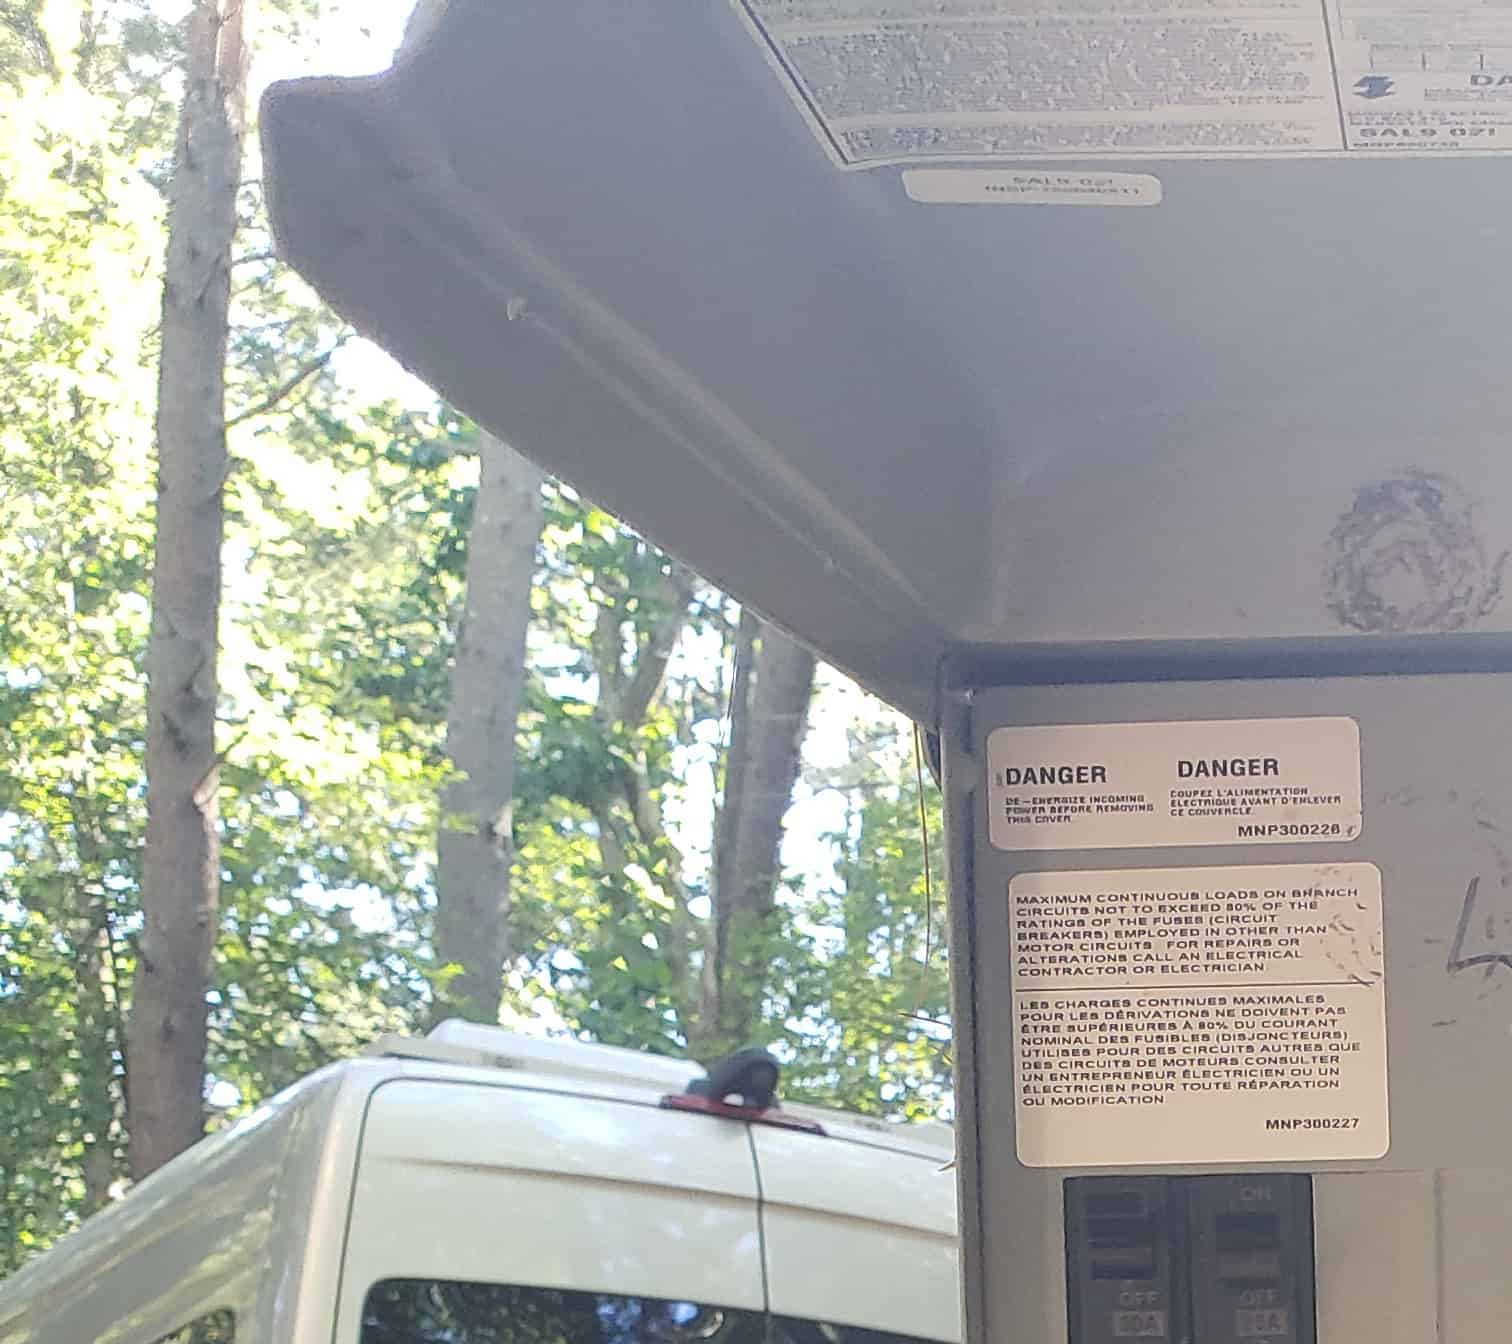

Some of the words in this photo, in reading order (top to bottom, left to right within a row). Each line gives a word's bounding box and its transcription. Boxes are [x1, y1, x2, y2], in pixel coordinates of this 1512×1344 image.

[1006, 766, 1106, 784] DANGER
[1178, 759, 1279, 777] DANGER
[1089, 795, 1144, 803] INCOMING
[1170, 789, 1212, 797] COUPEZ
[1216, 788, 1308, 796] L'ALIMENTATION
[1281, 796, 1341, 804] D'ENLEVER
[1005, 806, 1046, 814] POWER
[1049, 805, 1092, 813] BEFORE
[1096, 804, 1154, 812] REMOVING
[1170, 808, 1184, 816] CE
[1016, 895, 1092, 904] MAXIMUM
[1096, 892, 1199, 902] CONTINUOUS
[1205, 890, 1258, 900] LOADS
[1263, 890, 1286, 898] ON
[1291, 888, 1358, 897] BRANCH
[1016, 907, 1090, 916] CIRCUITS
[1094, 906, 1127, 914] NOT
[1131, 905, 1153, 913] TO
[1158, 903, 1221, 912] EXCEED
[1226, 903, 1256, 911] 80%
[1261, 902, 1282, 910] OF
[1288, 901, 1317, 910] THE
[1016, 919, 1086, 928] RATINGS
[1090, 918, 1112, 926] OF
[1117, 917, 1147, 925] THE
[1152, 916, 1203, 925] FUSES
[1208, 914, 1278, 924] (CIRCUIT
[1017, 931, 1109, 940] BREAKERS)
[1114, 928, 1200, 938] EMPLOYED
[1205, 927, 1220, 936] IN
[1225, 926, 1279, 935] OTHER
[1287, 925, 1331, 934] THAN
[1017, 943, 1074, 952] MOTOR
[1079, 941, 1152, 950] CIRCUITS
[1166, 940, 1198, 949] FOR
[1204, 938, 1272, 948] REPAIRS
[1277, 938, 1300, 946] OR
[1017, 954, 1127, 964] ALTERATIONS
[1132, 953, 1174, 961] CALL
[1178, 952, 1200, 960] AN
[1206, 950, 1303, 960] ELECTRICAL
[1018, 966, 1127, 976] CONTRACTOR
[1129, 965, 1155, 973] OR
[1020, 1001, 1049, 1009] LES
[1054, 999, 1131, 1008] CHARGES
[1136, 997, 1227, 1007] CONTINUES
[1232, 995, 1325, 1004] MAXIMALES
[1020, 1012, 1064, 1021] POUR
[1069, 1012, 1099, 1020] LES
[1104, 1010, 1210, 1019] DÉRIVATIONS
[1215, 1009, 1236, 1017] NE
[1241, 1007, 1310, 1016] DOIVENT
[1314, 1007, 1346, 1015] PAS
[1066, 1022, 1178, 1032] SUPÉRIEURES
[1198, 1021, 1229, 1029] 80%
[1234, 1020, 1256, 1029] DU
[1261, 1018, 1338, 1028] COURANT
[1020, 1036, 1093, 1045] NOMINAL
[1098, 1035, 1129, 1043] DES
[1134, 1034, 1210, 1042] FUSIBLES
[1215, 1032, 1348, 1041] (DISJONCTEURS)
[1096, 1047, 1140, 1056] POUR
[1145, 1046, 1177, 1055] DES
[1181, 1045, 1255, 1054] CIRCUITS
[1259, 1043, 1323, 1052] AUTRES
[1328, 1042, 1360, 1051] QUE
[1021, 1061, 1053, 1069] DES
[1057, 1059, 1131, 1069] CIRCUITS
[1136, 1058, 1157, 1067] DE
[1162, 1057, 1239, 1066] MOTEURS
[1241, 1055, 1340, 1065] CONSULTER
[1021, 1073, 1044, 1081] UN
[1049, 1070, 1176, 1080] ENTREPRENEUR
[1182, 1068, 1285, 1078] ÉLECTRICIEN
[1290, 1068, 1312, 1076] OU
[1317, 1067, 1340, 1075] UN
[1022, 1084, 1125, 1093] ÉLECTRICIEN
[1131, 1082, 1175, 1091] POUR
[1180, 1081, 1231, 1090] TOUTE
[1237, 1080, 1339, 1089] RÉPARATION
[1023, 1097, 1045, 1105] OU
[1266, 1118, 1360, 1129] MNP300227
